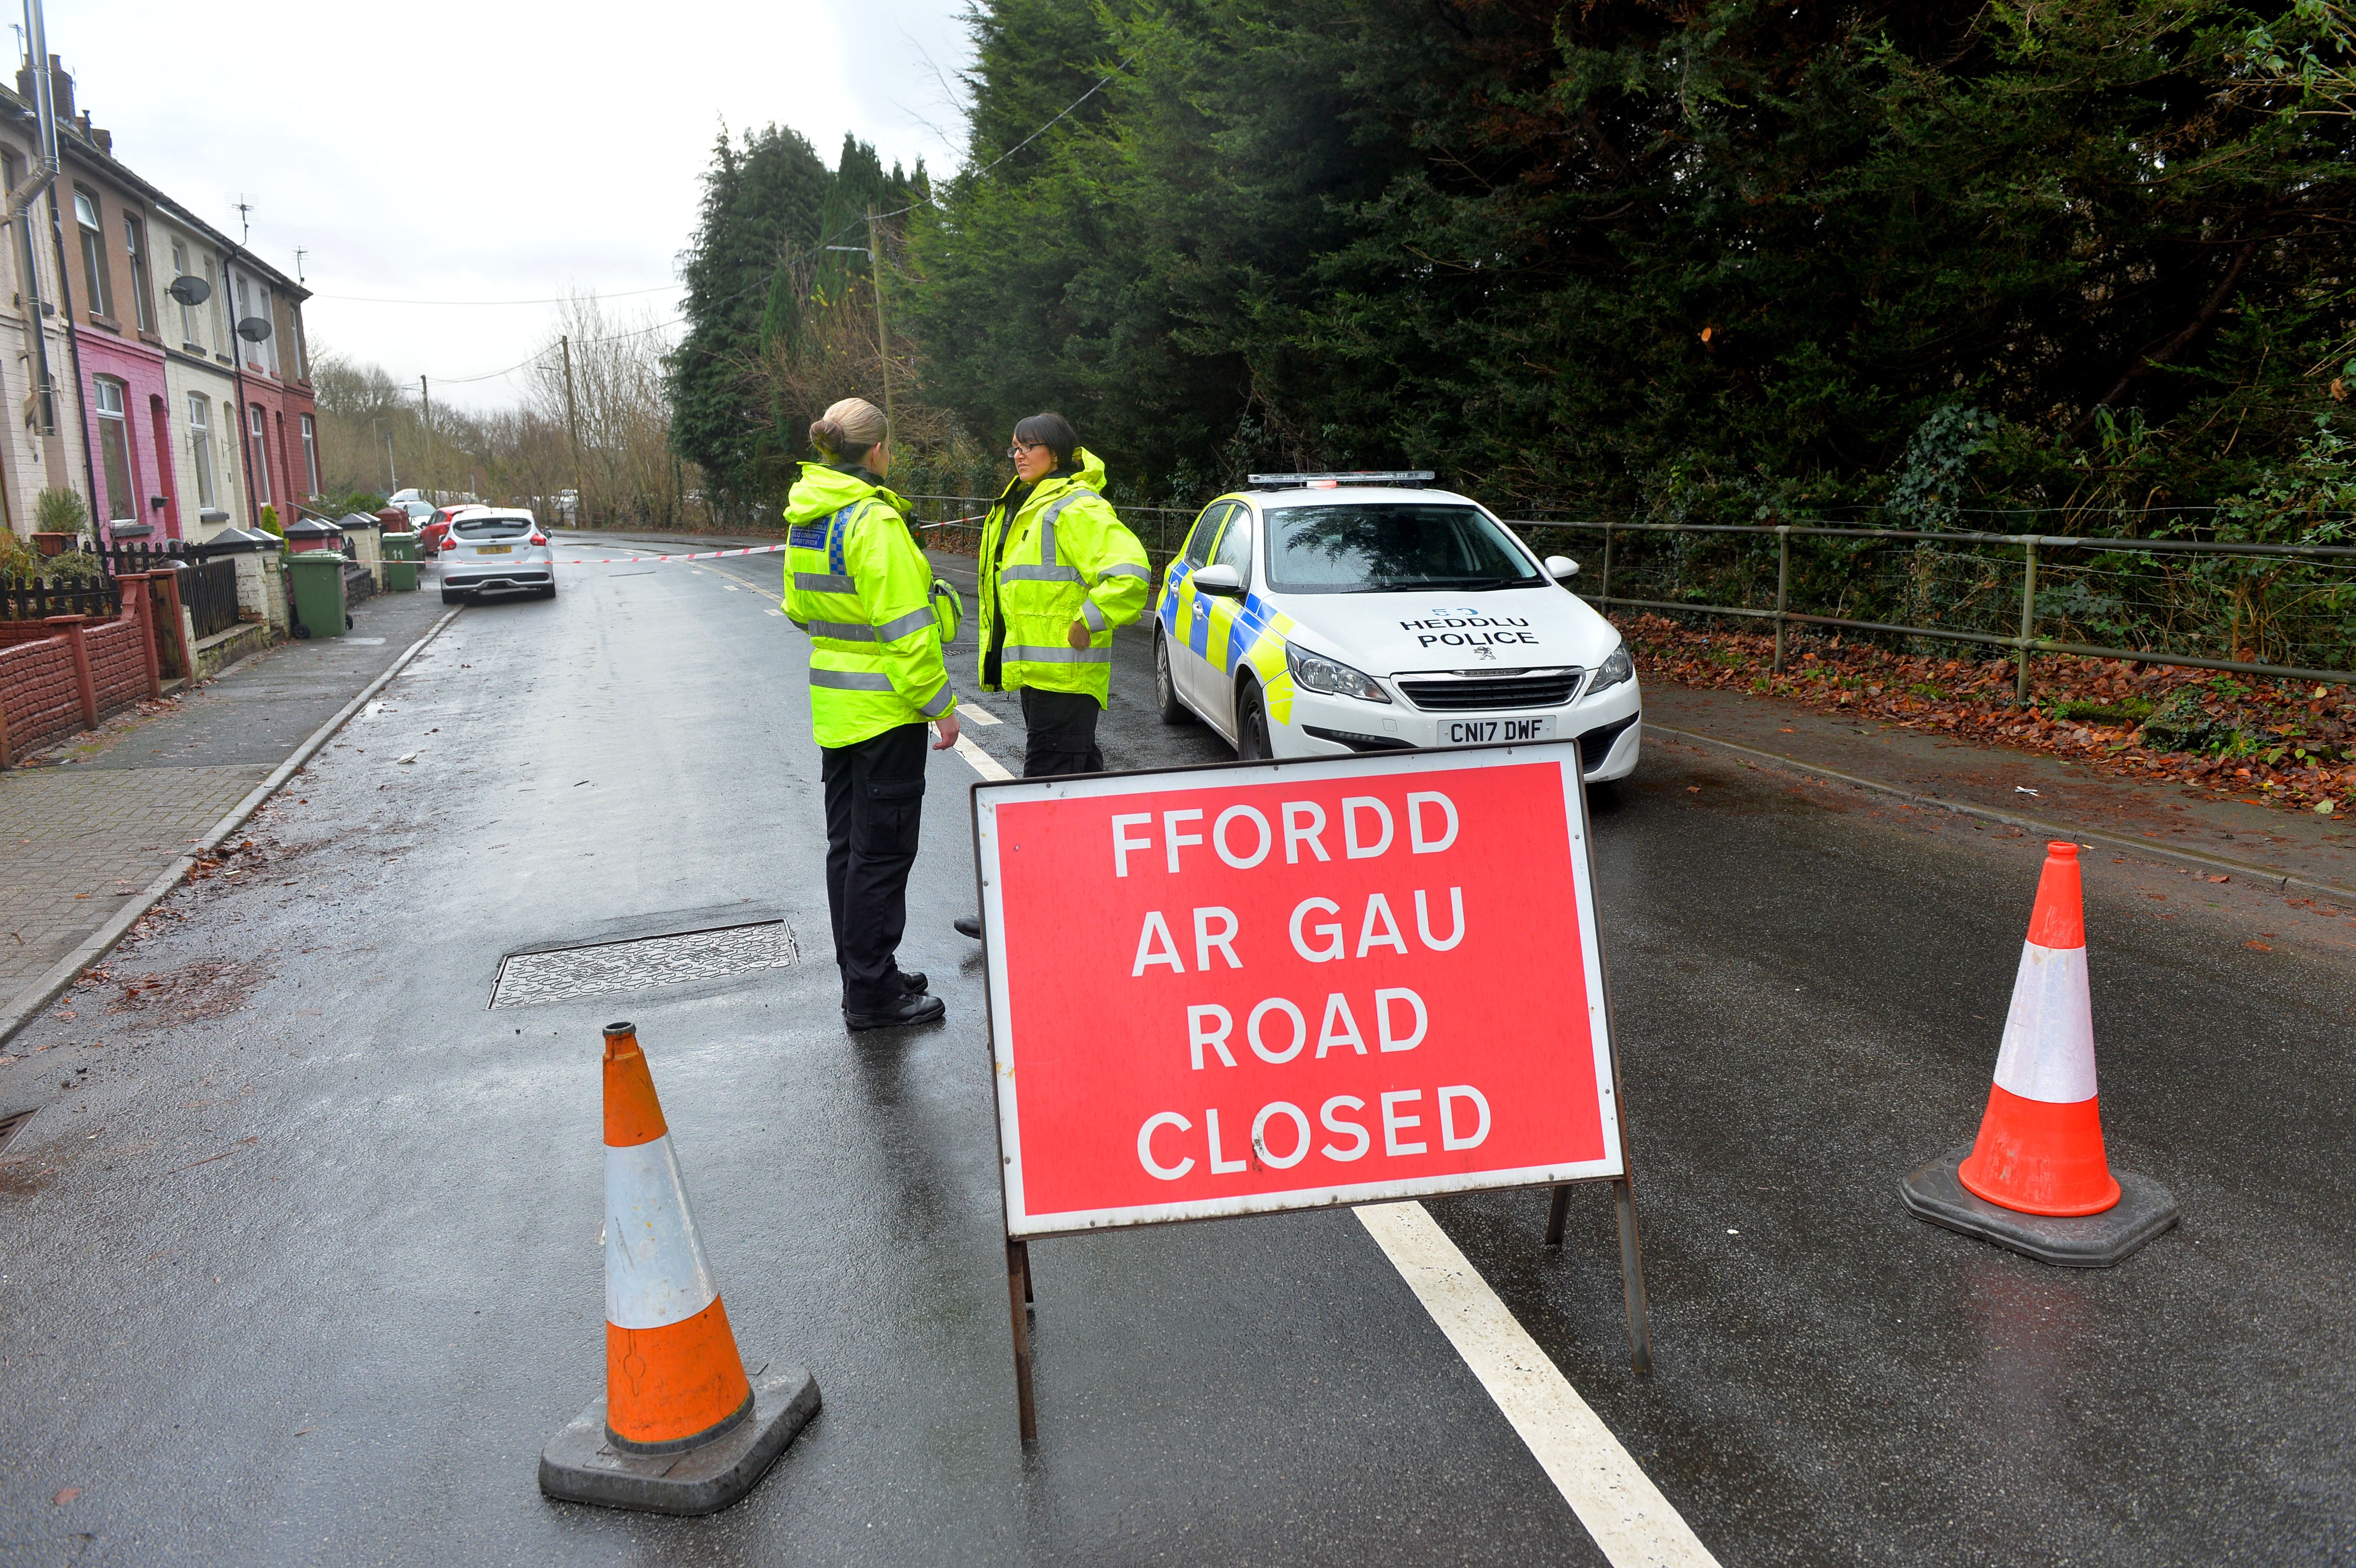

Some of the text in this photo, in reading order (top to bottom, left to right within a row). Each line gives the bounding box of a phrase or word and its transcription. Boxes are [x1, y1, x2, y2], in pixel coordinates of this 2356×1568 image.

[392, 549, 404, 560] 11
[1399, 618, 1529, 631] HEDDLU
[1417, 632, 1539, 648] POLICE
[1451, 719, 1543, 743] CN17 DWF
[1111, 791, 1459, 878] FFORDD
[1132, 887, 1465, 977] AR GAU
[1187, 988, 1428, 1070] ROAD
[1137, 1085, 1491, 1180] CLOSED
